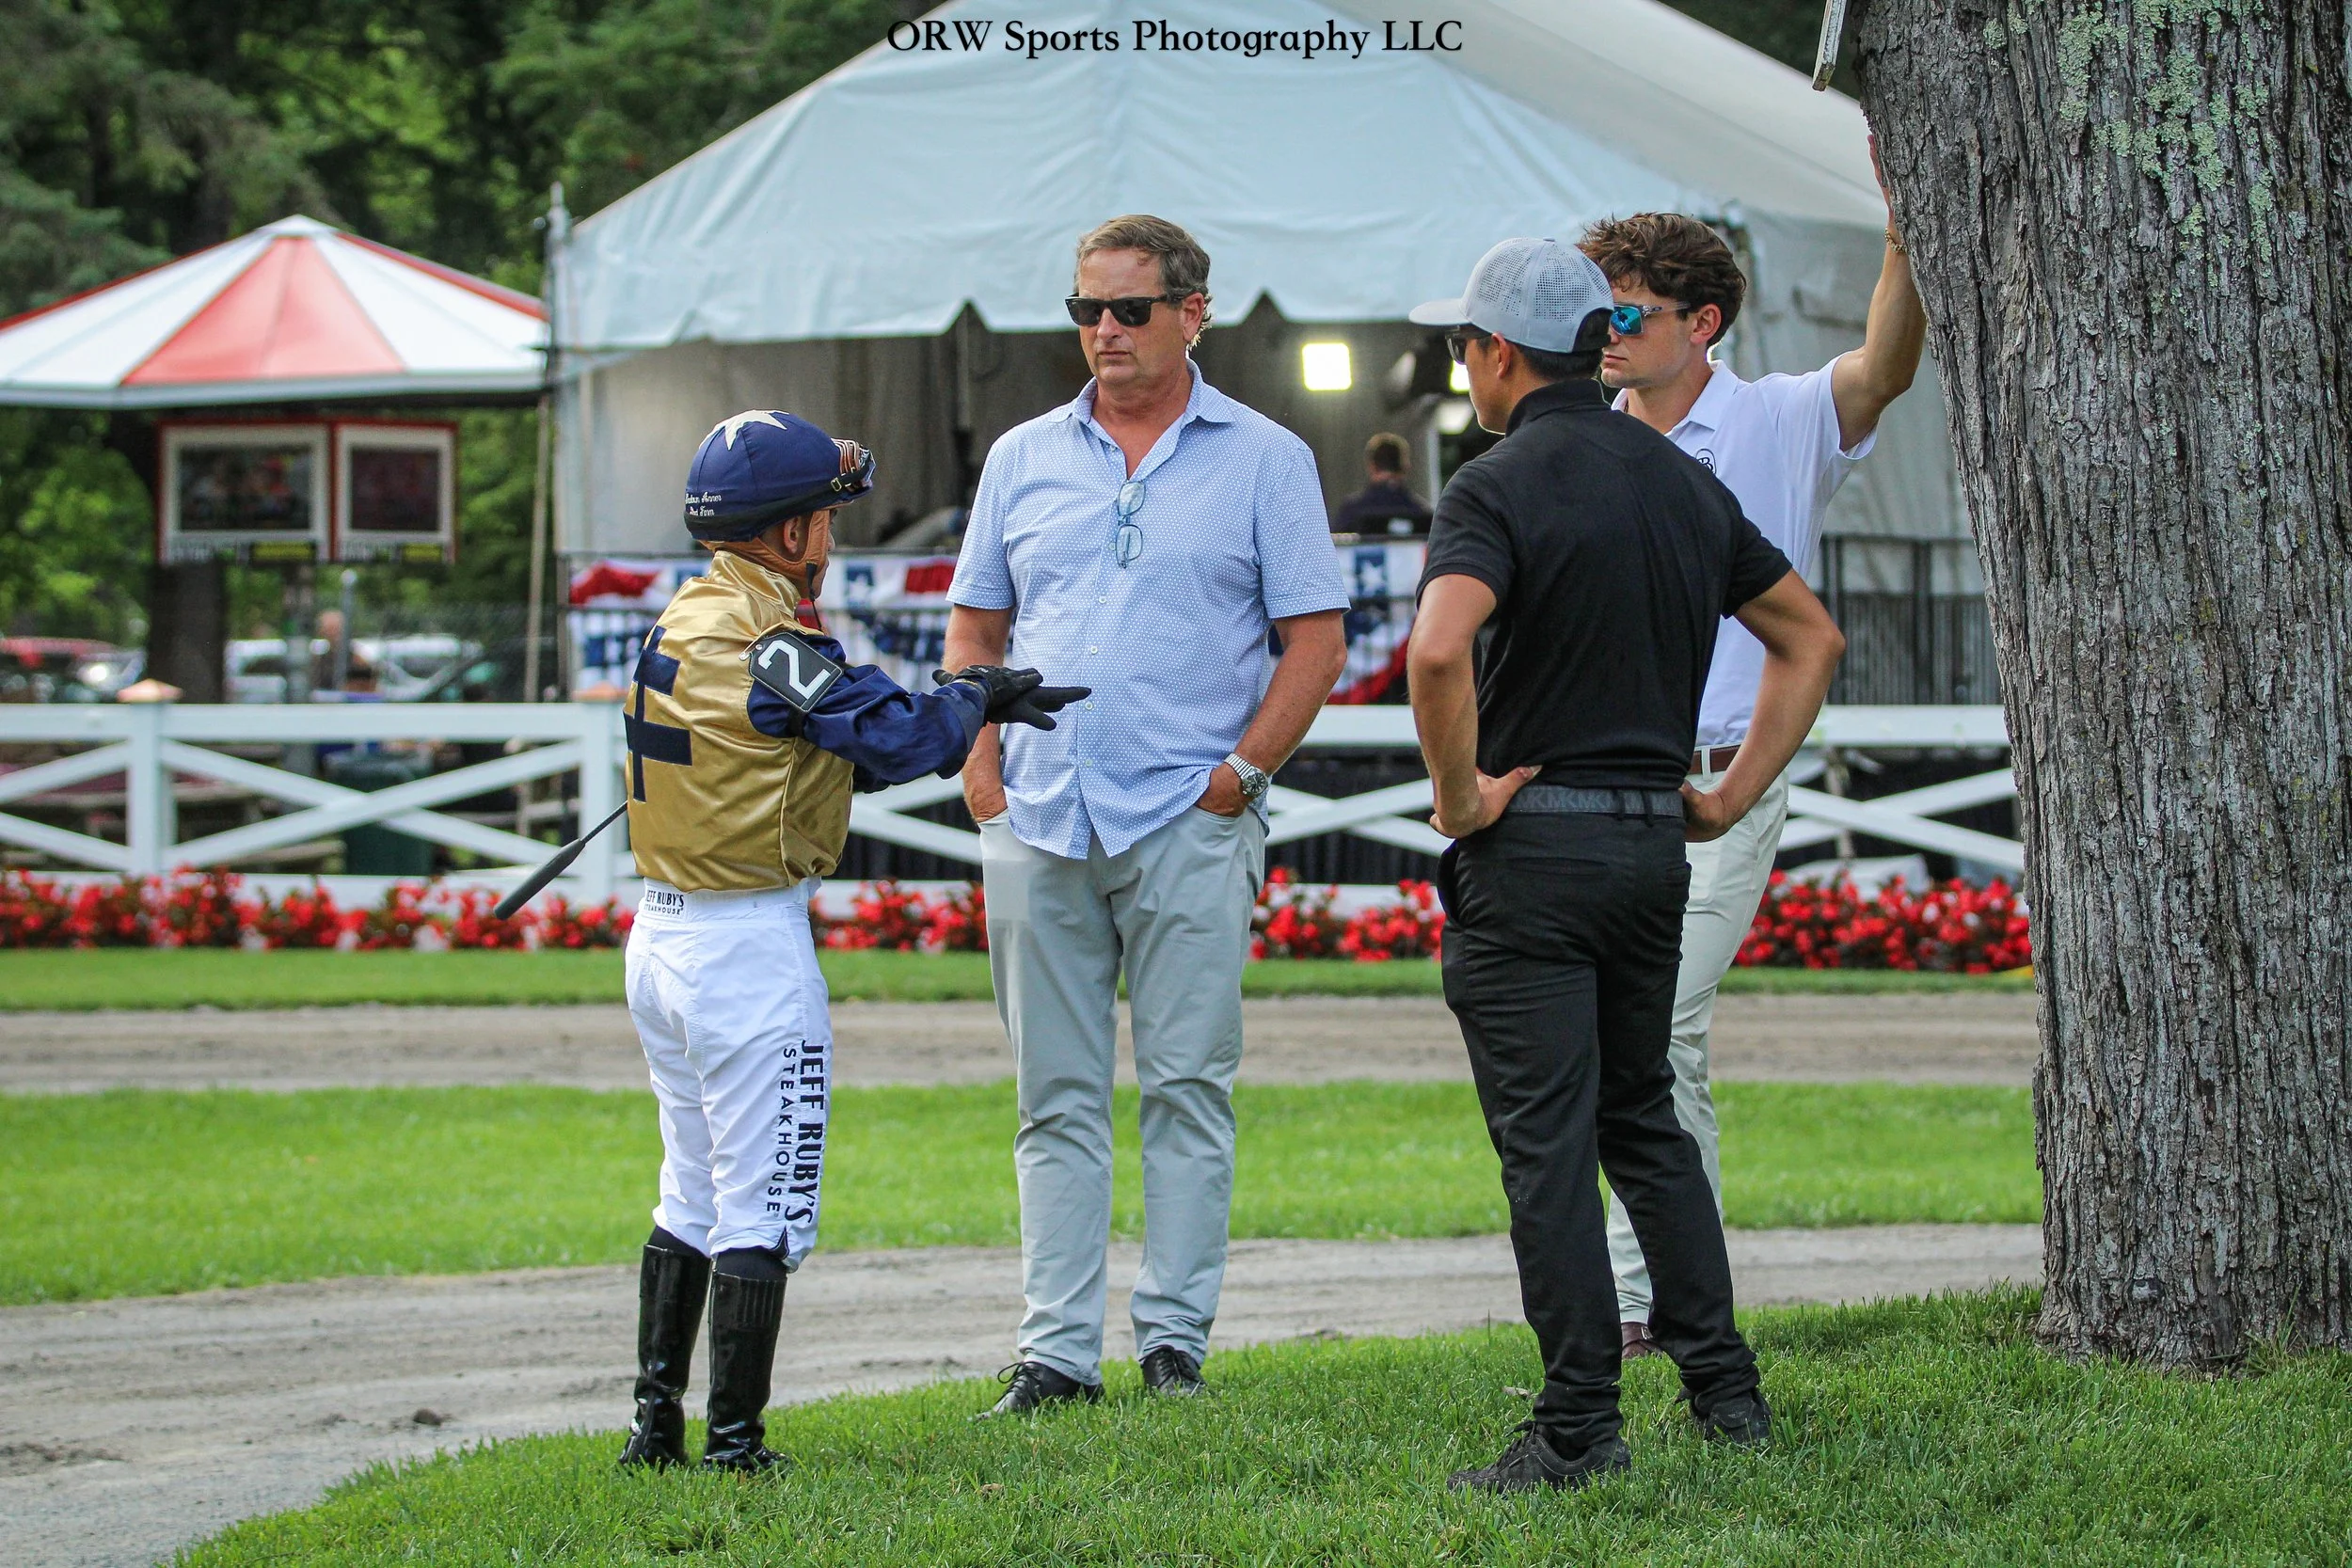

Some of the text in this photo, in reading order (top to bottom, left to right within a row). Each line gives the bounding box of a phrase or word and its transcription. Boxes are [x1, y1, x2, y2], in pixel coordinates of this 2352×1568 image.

[757, 640, 832, 700] 2
[657, 892, 684, 908] RUBY'S
[767, 1048, 797, 1212] STEAKHOUSE
[785, 1039, 824, 1224] JEFF RUBY'S
